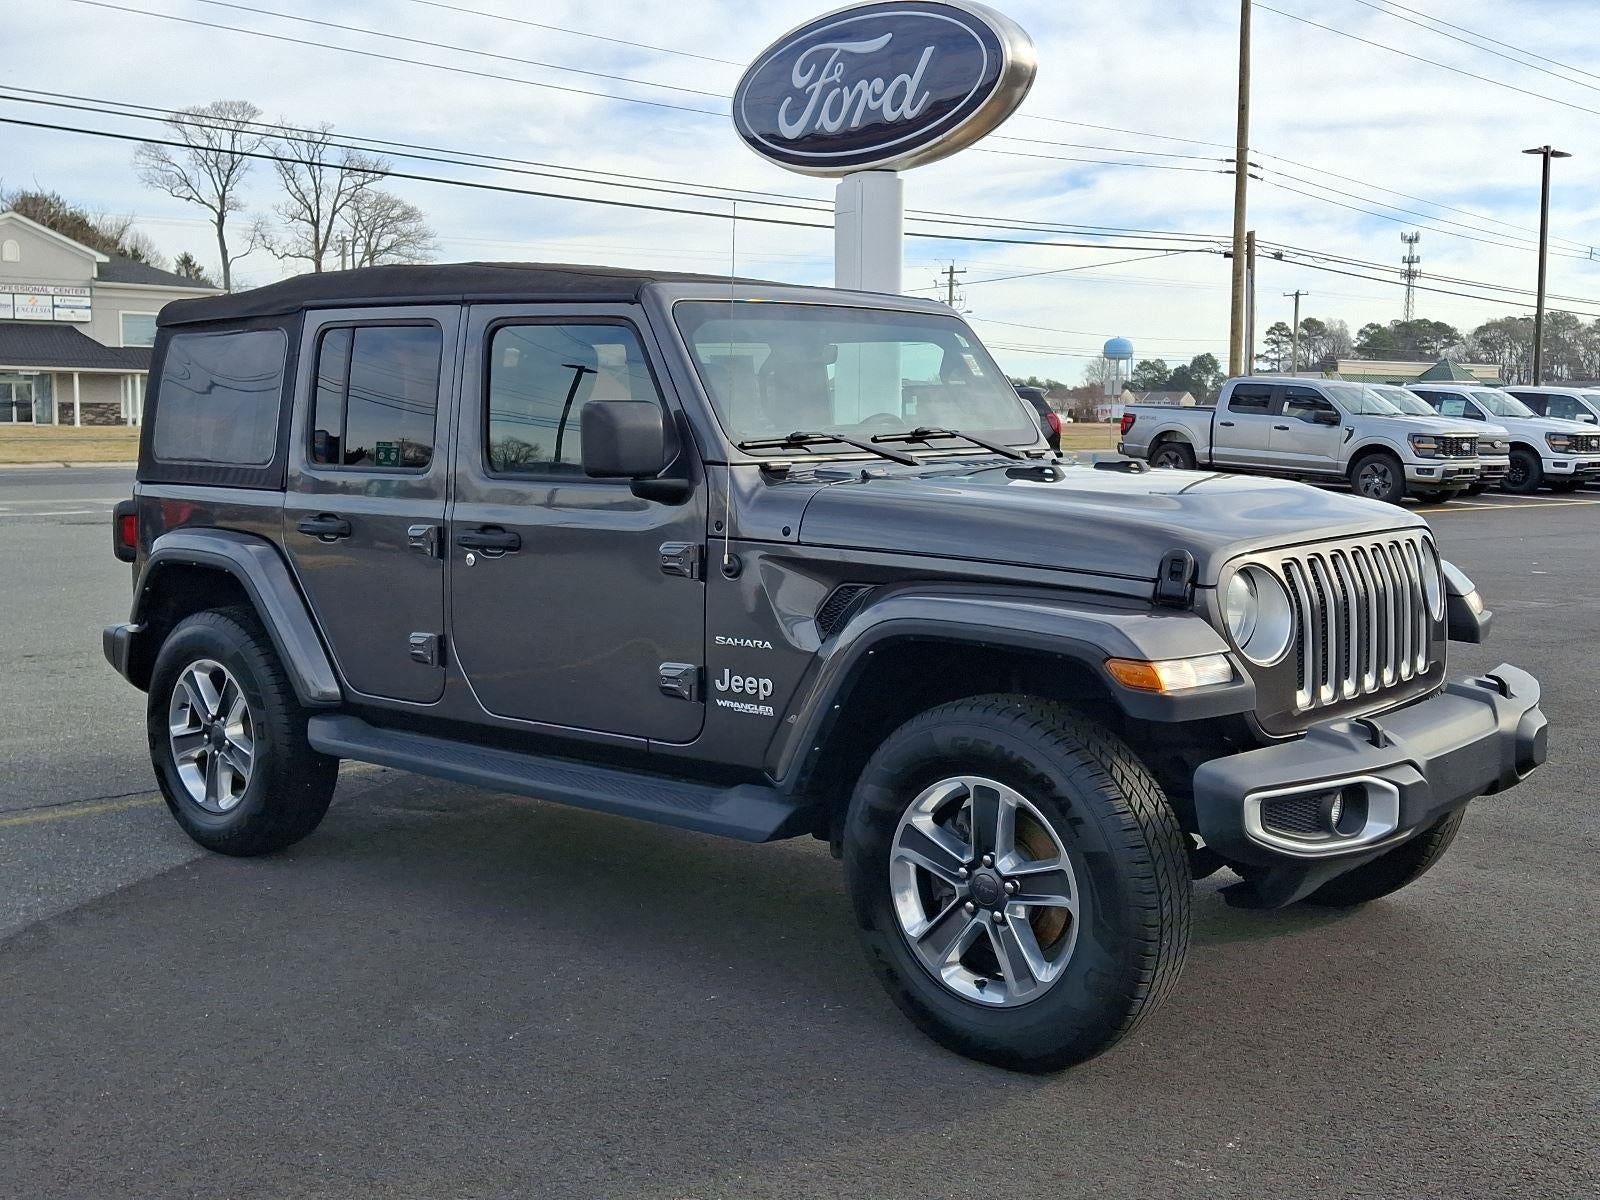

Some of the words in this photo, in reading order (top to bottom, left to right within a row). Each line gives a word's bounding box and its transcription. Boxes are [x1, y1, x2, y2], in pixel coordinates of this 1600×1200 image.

[778, 32, 935, 140] Ford
[53, 287, 86, 295] CENTER
[715, 635, 773, 650] SAHARA
[715, 668, 773, 701] Jeep
[716, 698, 773, 713] WRANGLER
